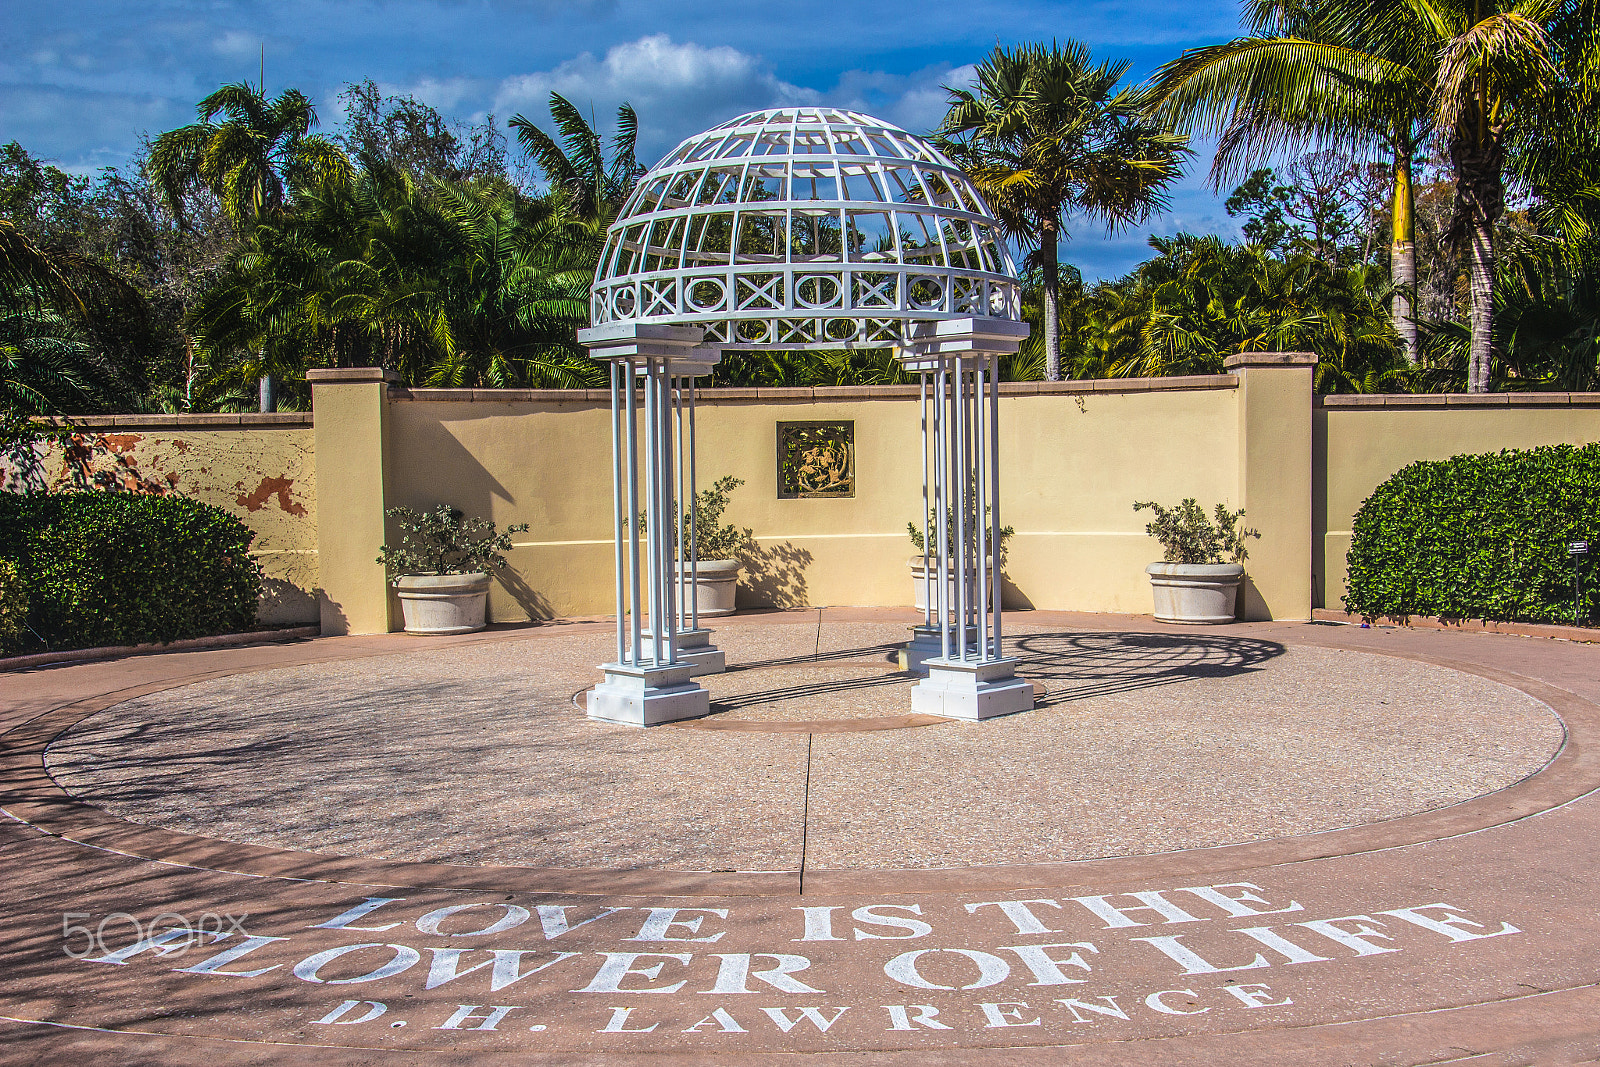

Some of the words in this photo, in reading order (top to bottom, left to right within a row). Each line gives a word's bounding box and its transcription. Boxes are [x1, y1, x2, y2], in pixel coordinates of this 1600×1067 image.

[305, 897, 729, 943] LOVE
[791, 903, 933, 942] IS
[964, 881, 1305, 935] THE
[81, 926, 827, 994] FLOWER
[883, 941, 1100, 990] OF
[1130, 902, 1522, 976] LIFE
[308, 1000, 408, 1028] D.
[431, 1004, 547, 1032] H.
[596, 983, 1294, 1033] LAWRENCE
